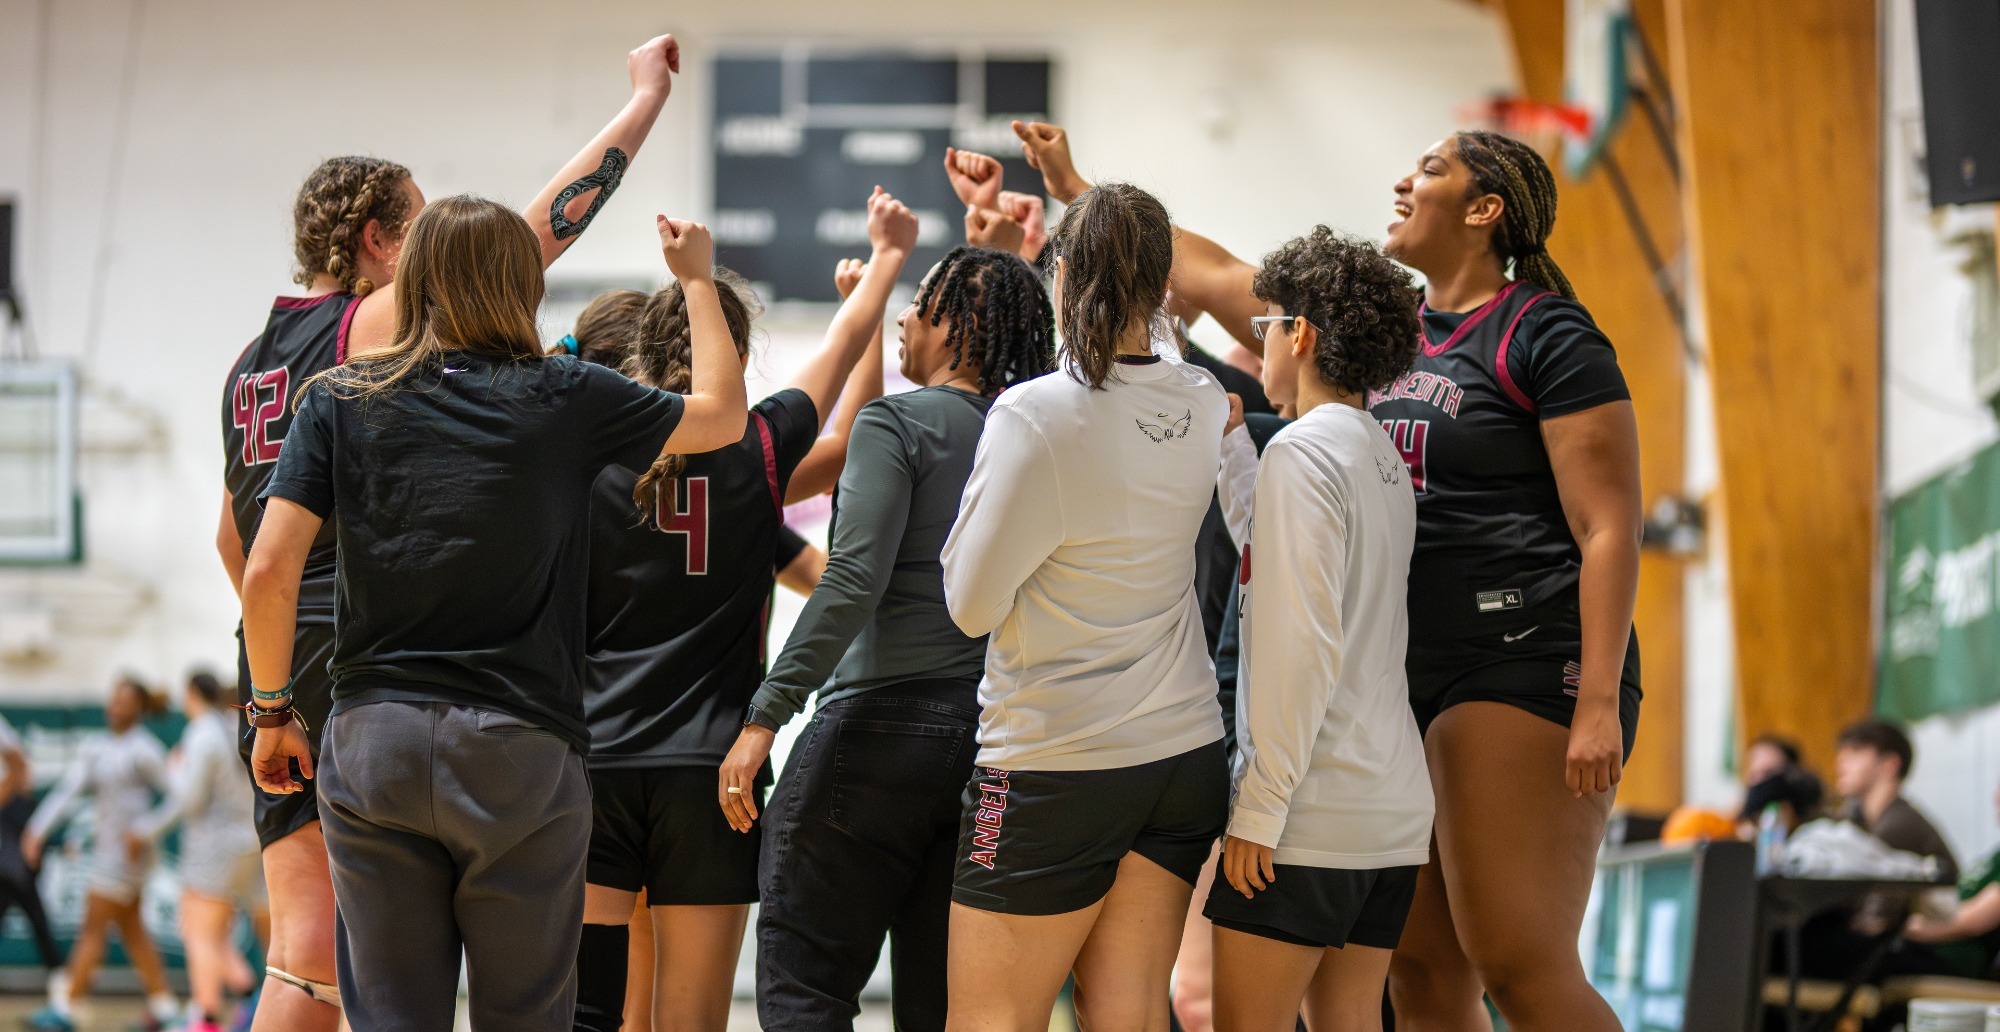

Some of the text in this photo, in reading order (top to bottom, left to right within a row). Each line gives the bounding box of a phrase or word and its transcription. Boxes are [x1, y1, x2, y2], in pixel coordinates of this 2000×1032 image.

[233, 365, 289, 467] 42
[655, 476, 709, 575] 4
[1505, 594, 1518, 604] XL
